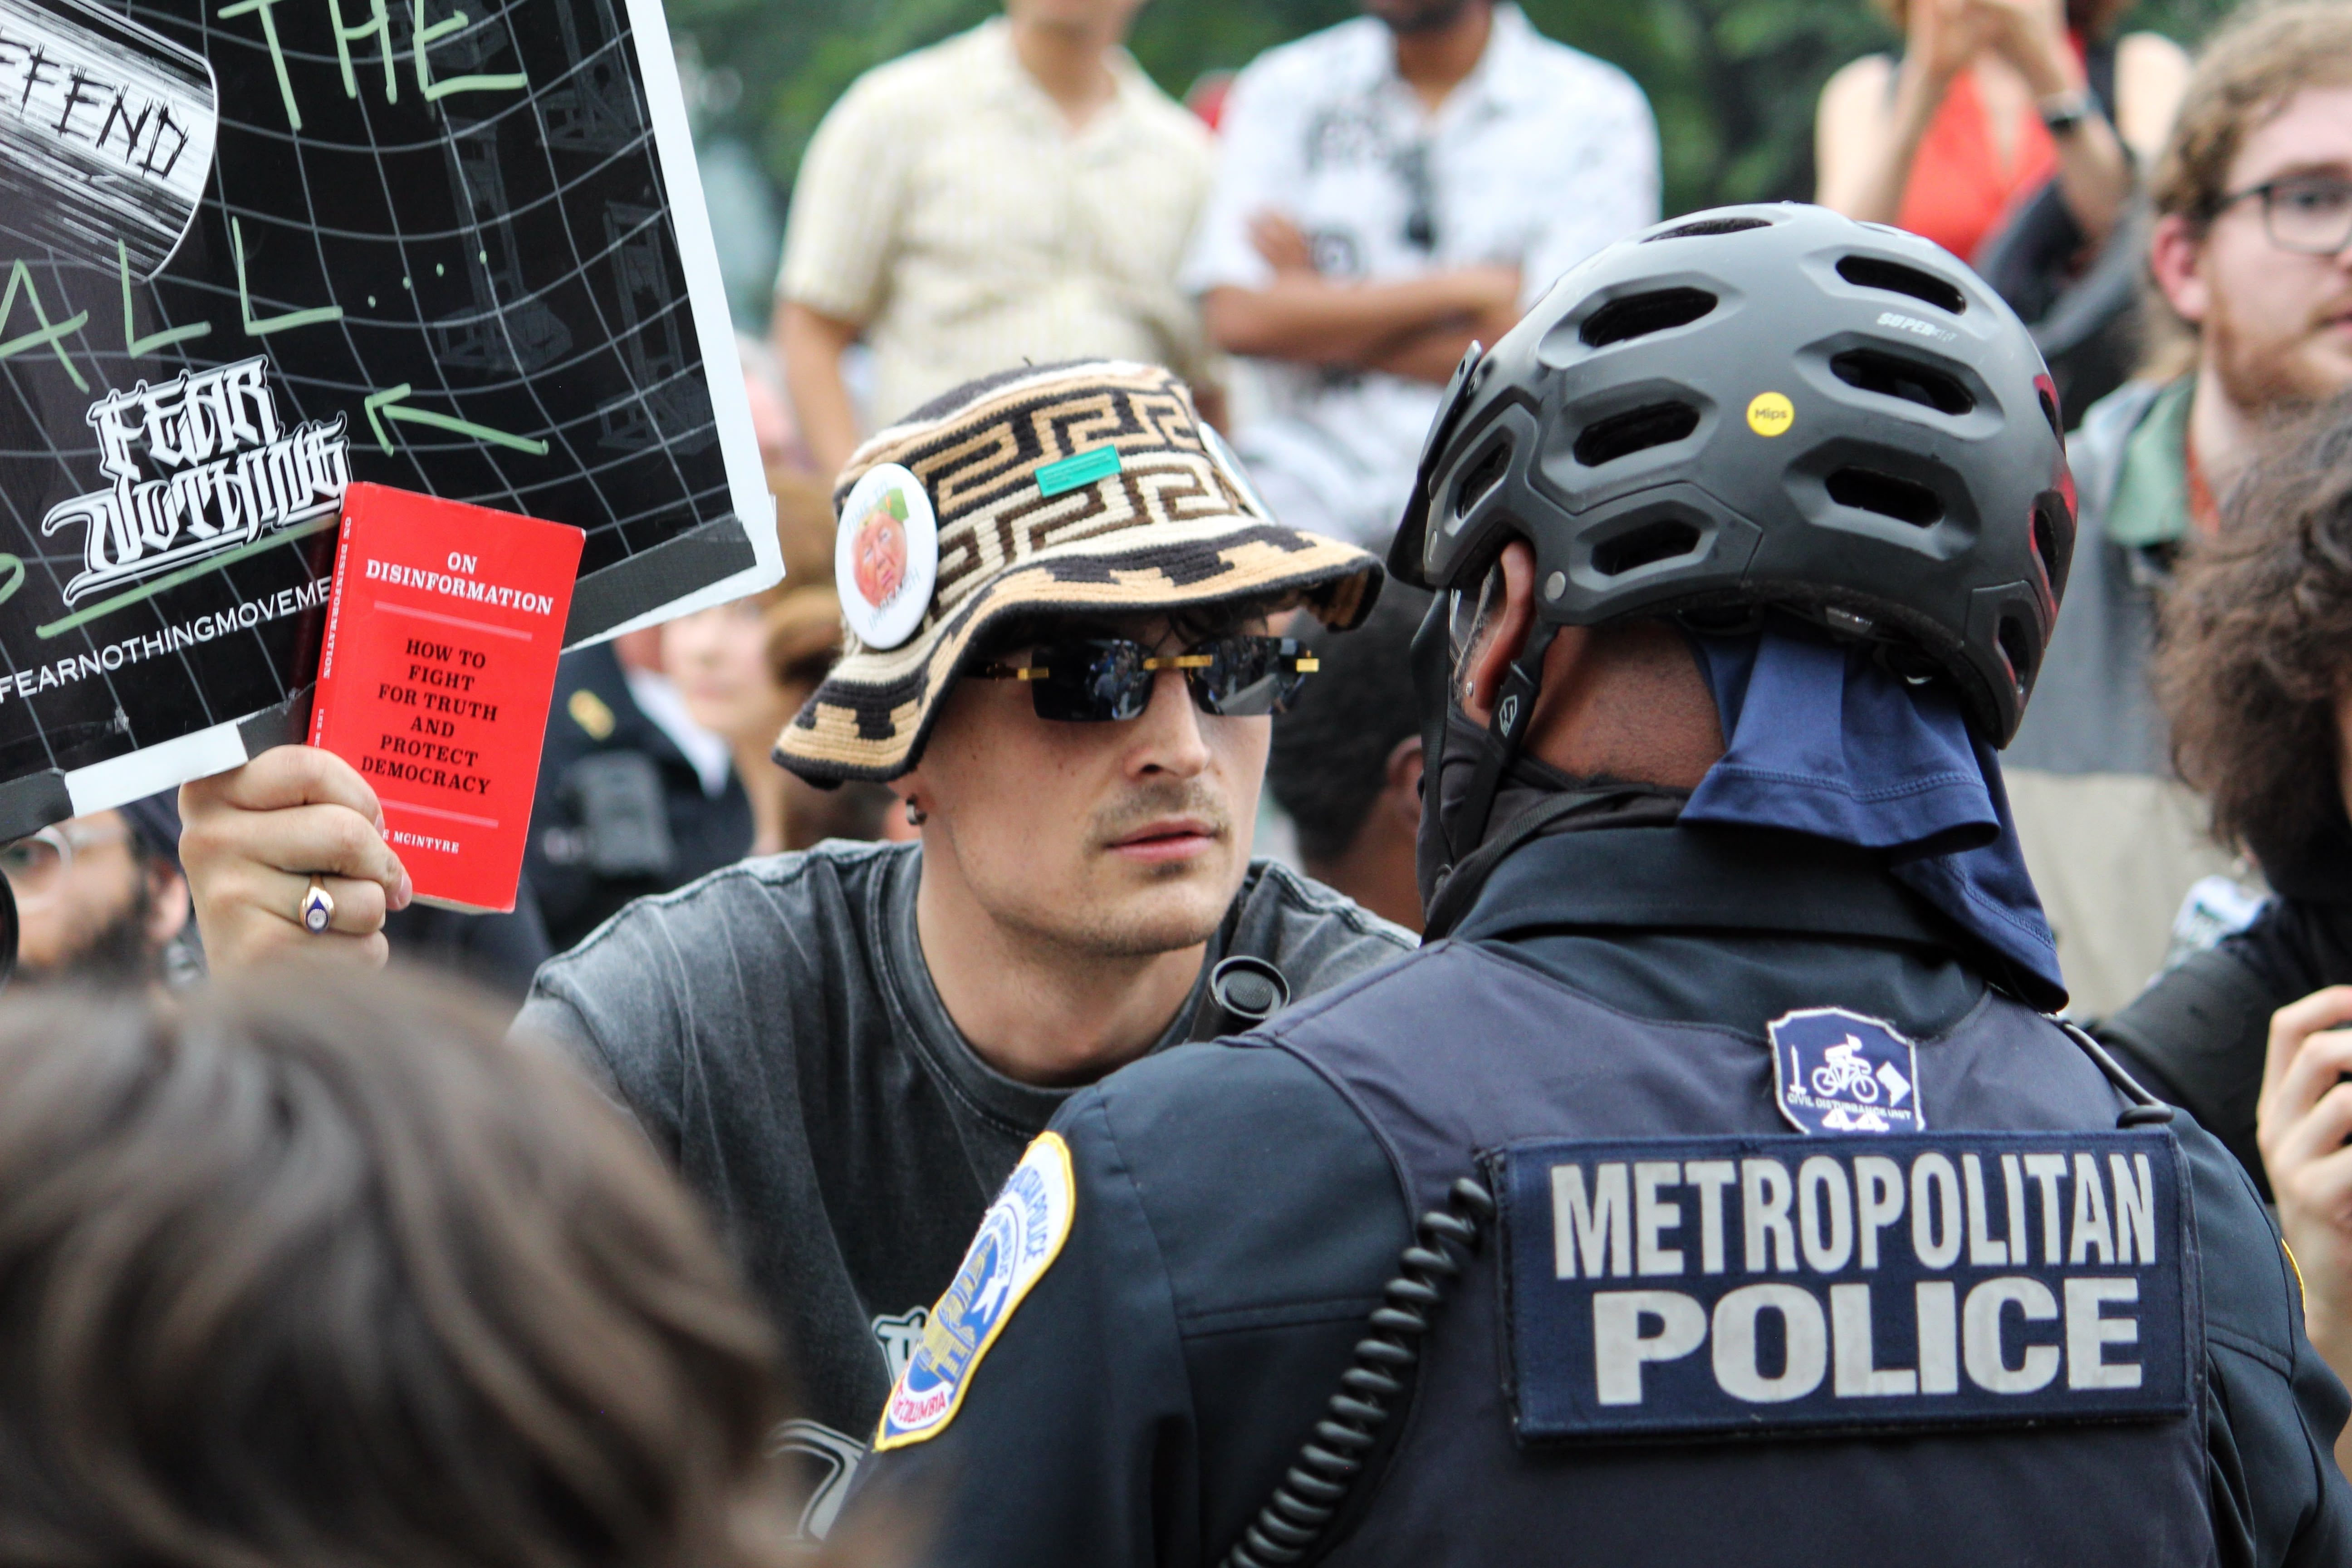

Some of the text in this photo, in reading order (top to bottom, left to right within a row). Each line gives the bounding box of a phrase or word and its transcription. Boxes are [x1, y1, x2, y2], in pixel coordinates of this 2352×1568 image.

[217, 0, 527, 130] THE
[86, 354, 278, 482] FEAR
[1754, 407, 1787, 421] Mips
[42, 411, 352, 606] NOTHING
[447, 551, 478, 575] ON
[323, 516, 352, 679] ON DISINFORMATION
[365, 559, 554, 616] DISINFORMATION
[406, 638, 486, 669] HOW TO
[408, 663, 475, 691] FIGHT
[378, 683, 498, 721] FOR TRUTH
[411, 715, 455, 739] AND
[380, 734, 479, 767] PROTECT
[361, 756, 491, 795] DEMOCRACY
[393, 830, 460, 854] MCINTYRE
[1787, 1092, 1814, 1107] CIVIL
[1888, 1108, 1911, 1120] UNIT
[1550, 1152, 2156, 1279] METROPOLITAN
[1593, 1277, 2142, 1406] POLICE
